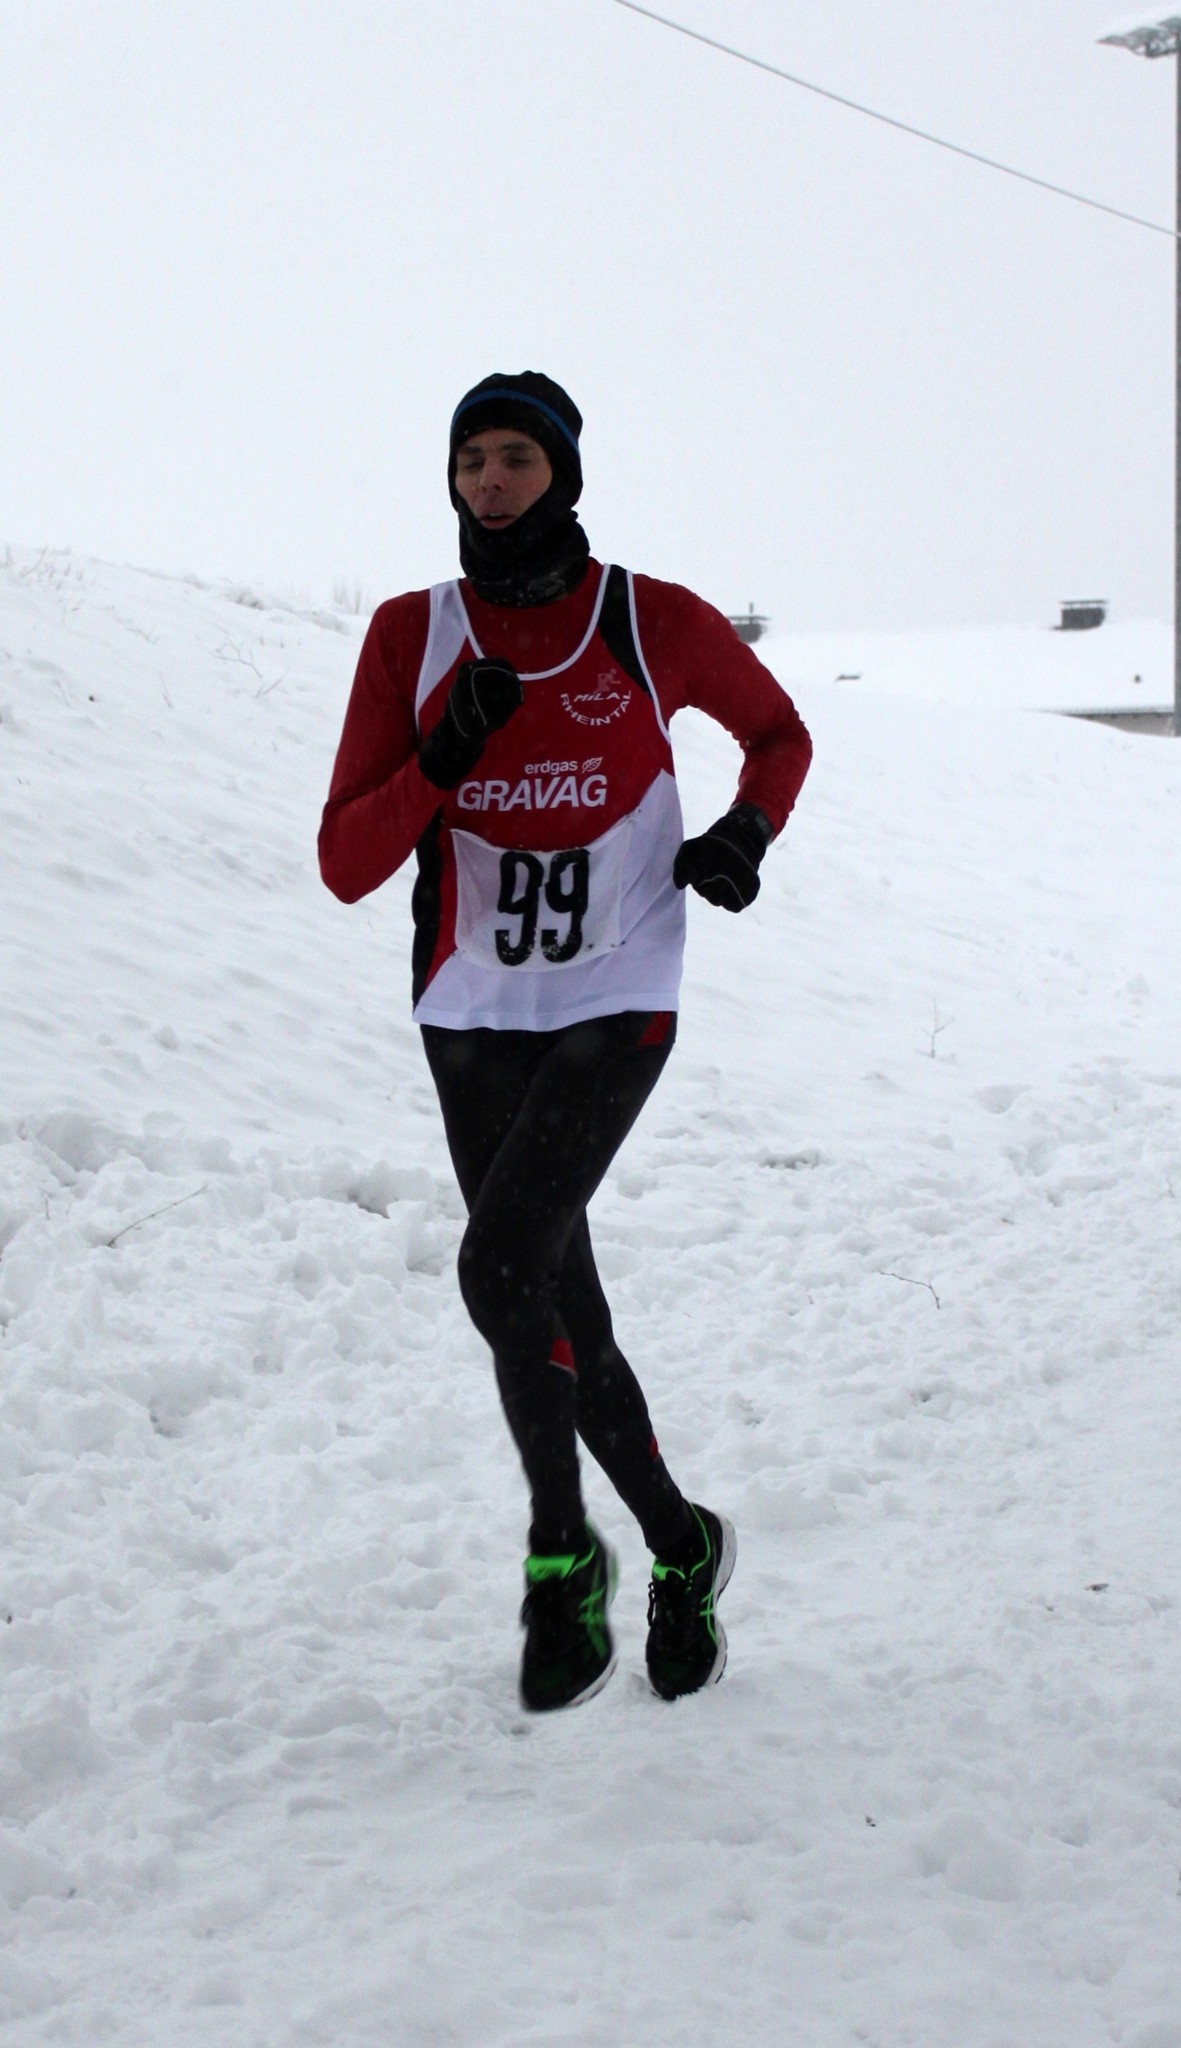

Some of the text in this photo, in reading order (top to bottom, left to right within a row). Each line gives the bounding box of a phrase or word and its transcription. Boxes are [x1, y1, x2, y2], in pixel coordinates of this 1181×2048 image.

[560, 690, 631, 726] RHEINTAL
[525, 760, 577, 774] erdgas
[457, 775, 607, 811] GRAVAG
[495, 848, 590, 966] 99
